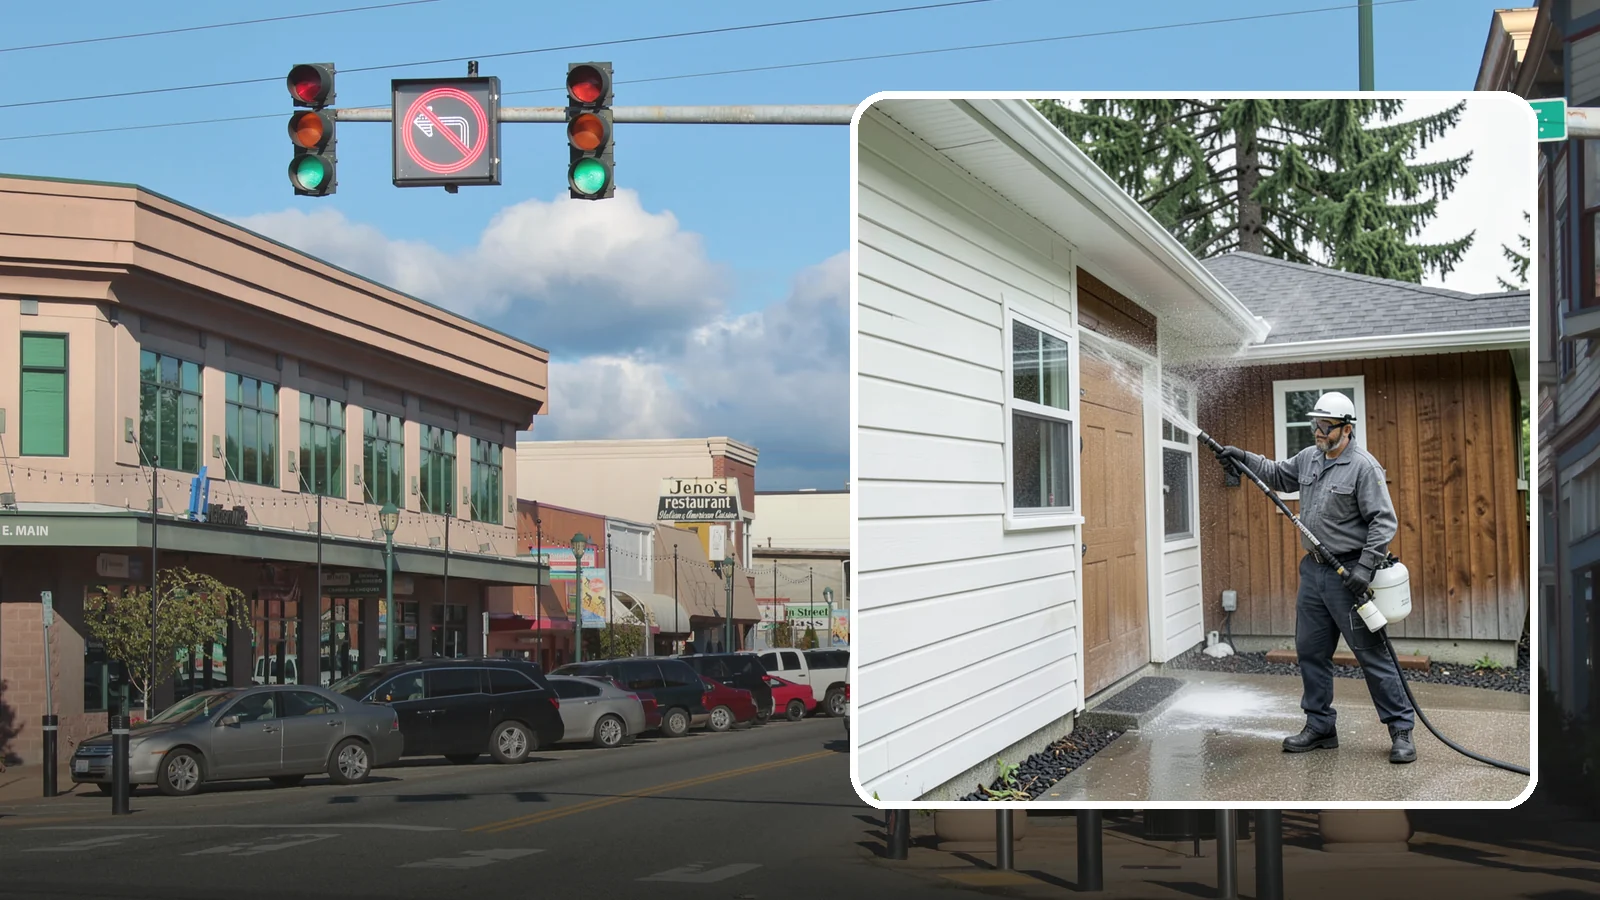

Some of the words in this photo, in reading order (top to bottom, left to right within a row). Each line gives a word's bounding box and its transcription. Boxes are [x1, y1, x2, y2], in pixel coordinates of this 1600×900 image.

[669, 480, 728, 494] Jeno's
[665, 496, 731, 509] restaurant
[658, 510, 681, 520] Italian
[686, 509, 714, 520] American
[715, 509, 737, 519] Cuisine
[2, 525, 13, 536] E.
[15, 525, 49, 536] MAIN
[797, 607, 828, 616] Street
[790, 619, 823, 627] lass
